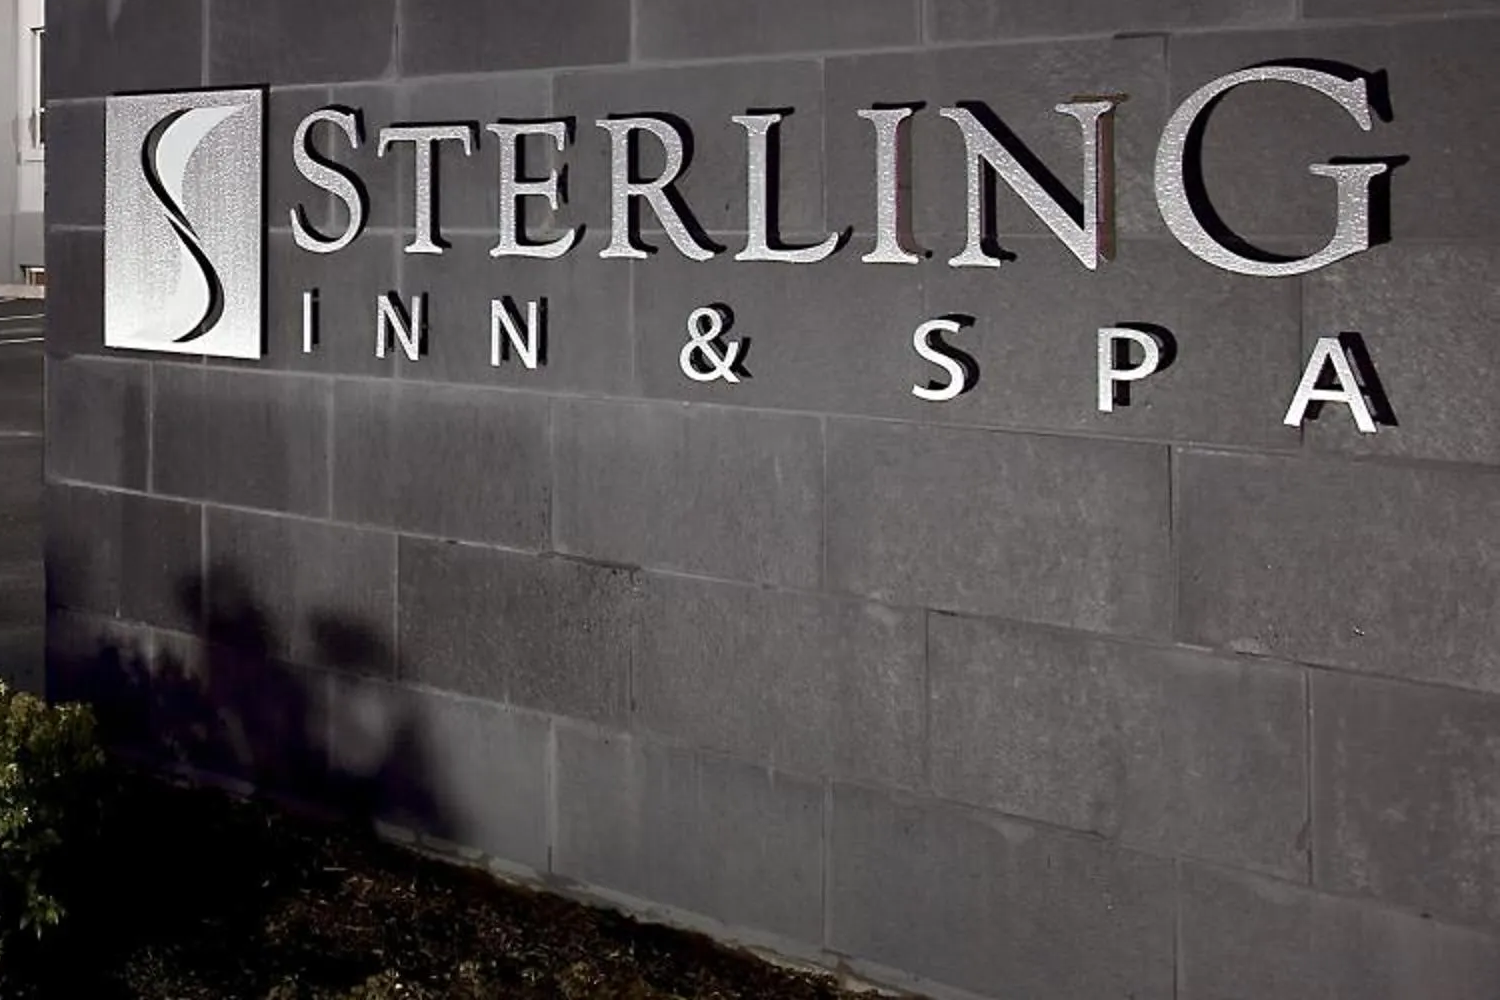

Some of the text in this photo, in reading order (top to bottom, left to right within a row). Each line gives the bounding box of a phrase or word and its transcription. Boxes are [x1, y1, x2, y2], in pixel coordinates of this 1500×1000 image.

[290, 64, 1389, 278] STERLING
[302, 291, 1380, 434] INN & SPA
